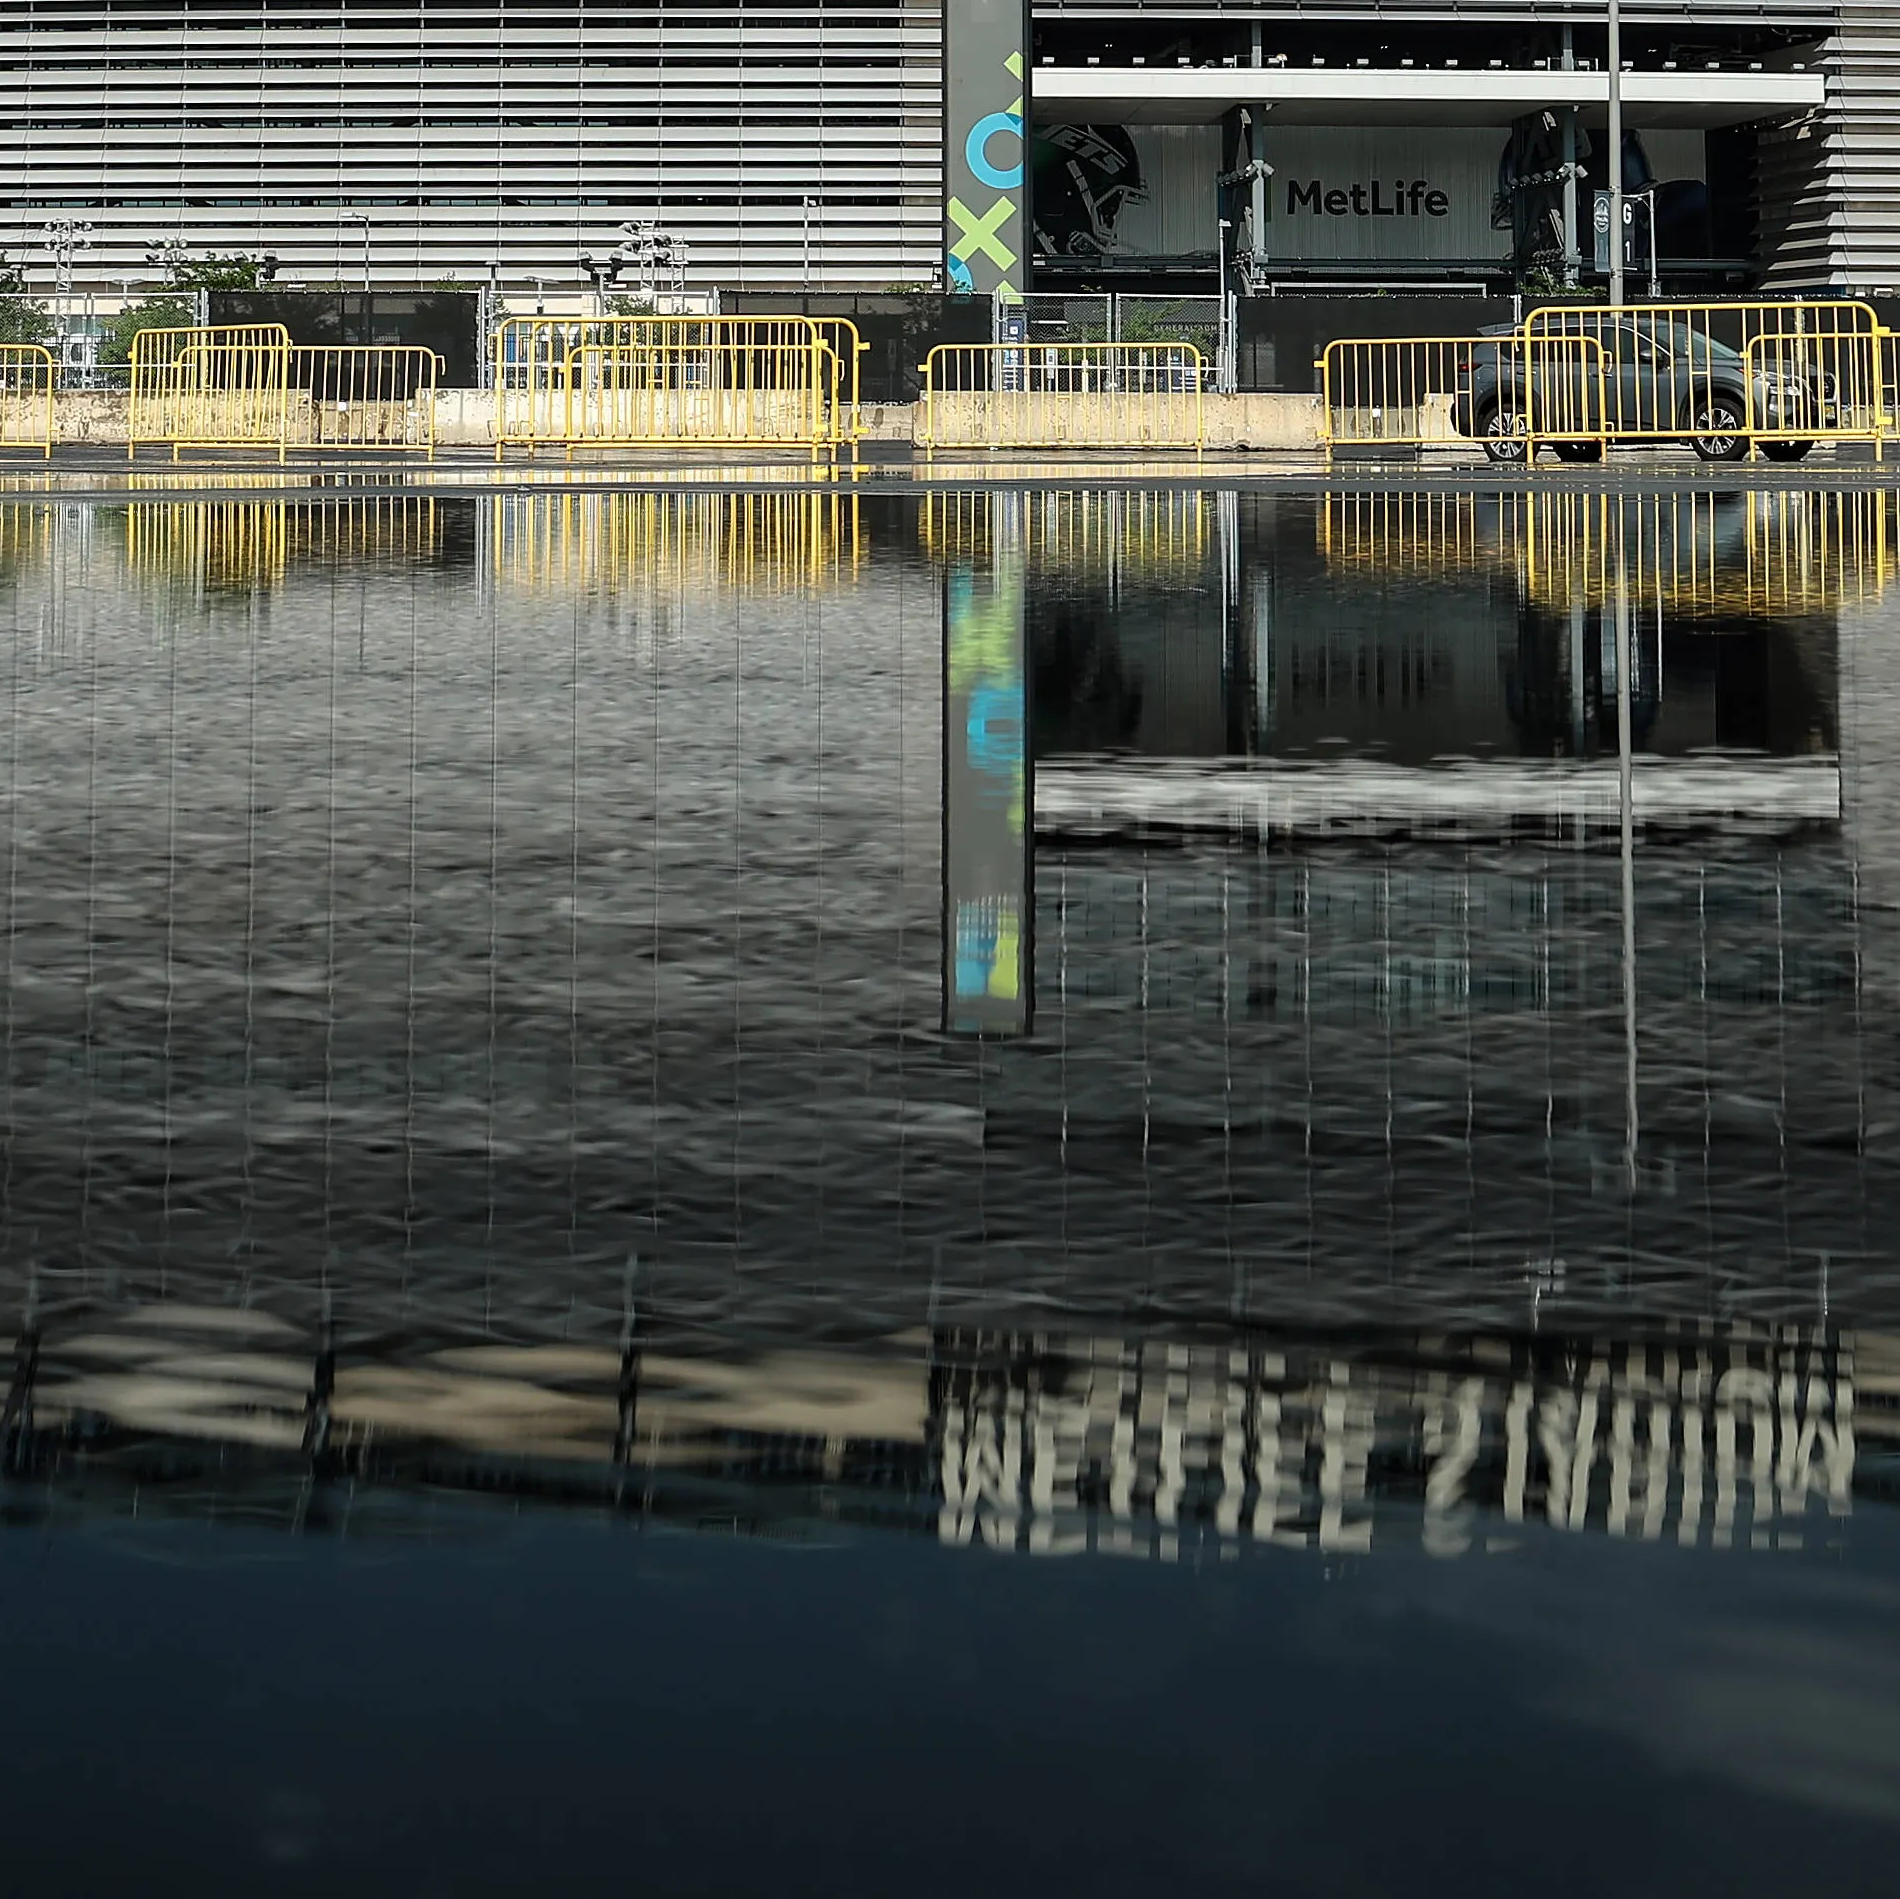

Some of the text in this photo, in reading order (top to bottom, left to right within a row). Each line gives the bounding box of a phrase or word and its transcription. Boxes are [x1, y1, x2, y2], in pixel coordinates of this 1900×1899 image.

[1286, 177, 1449, 217] MetLife
[1622, 202, 1632, 225] G
[1625, 240, 1631, 262] 1
